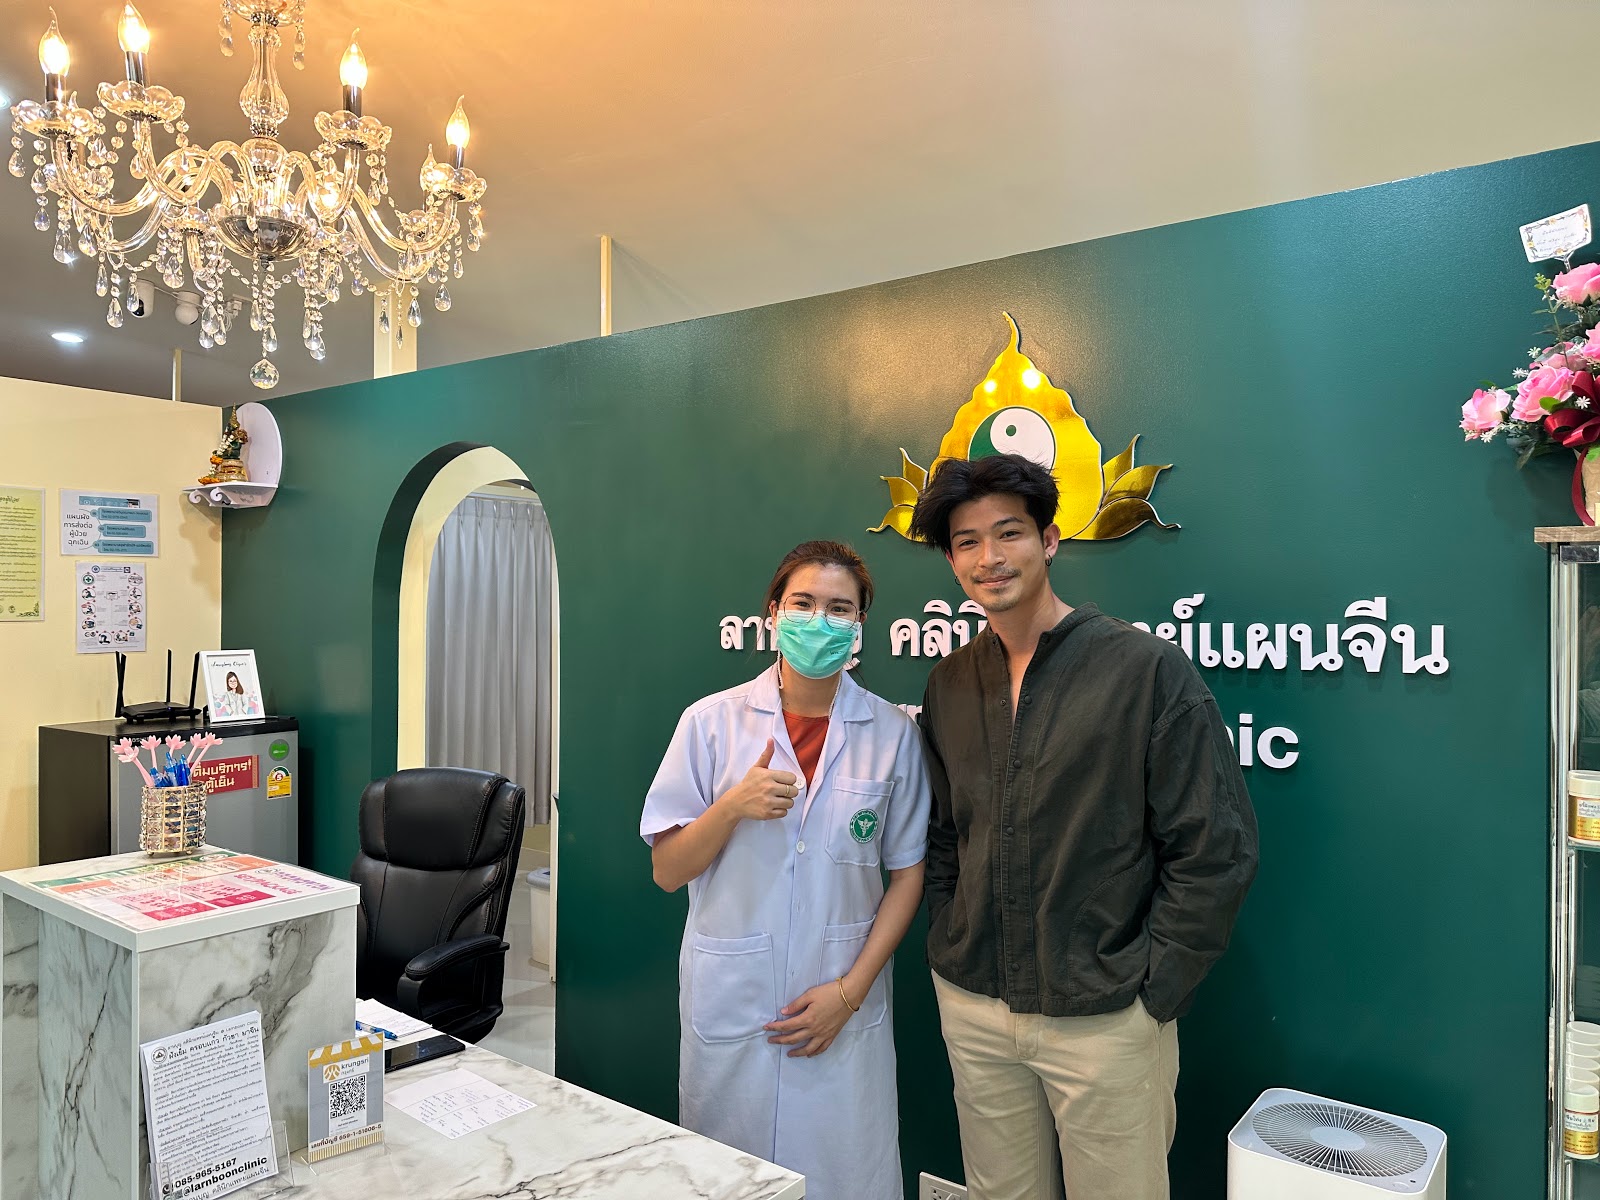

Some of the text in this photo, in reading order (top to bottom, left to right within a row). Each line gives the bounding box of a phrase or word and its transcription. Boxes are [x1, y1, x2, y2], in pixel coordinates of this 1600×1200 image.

[69, 529, 88, 538] ผู้ป่วย
[68, 538, 89, 547] ฉุกเฉิน
[189, 1036, 220, 1052] ครอบแก้ว
[341, 1057, 369, 1070] krungsri
[183, 1156, 268, 1196] @larnboonclinic
